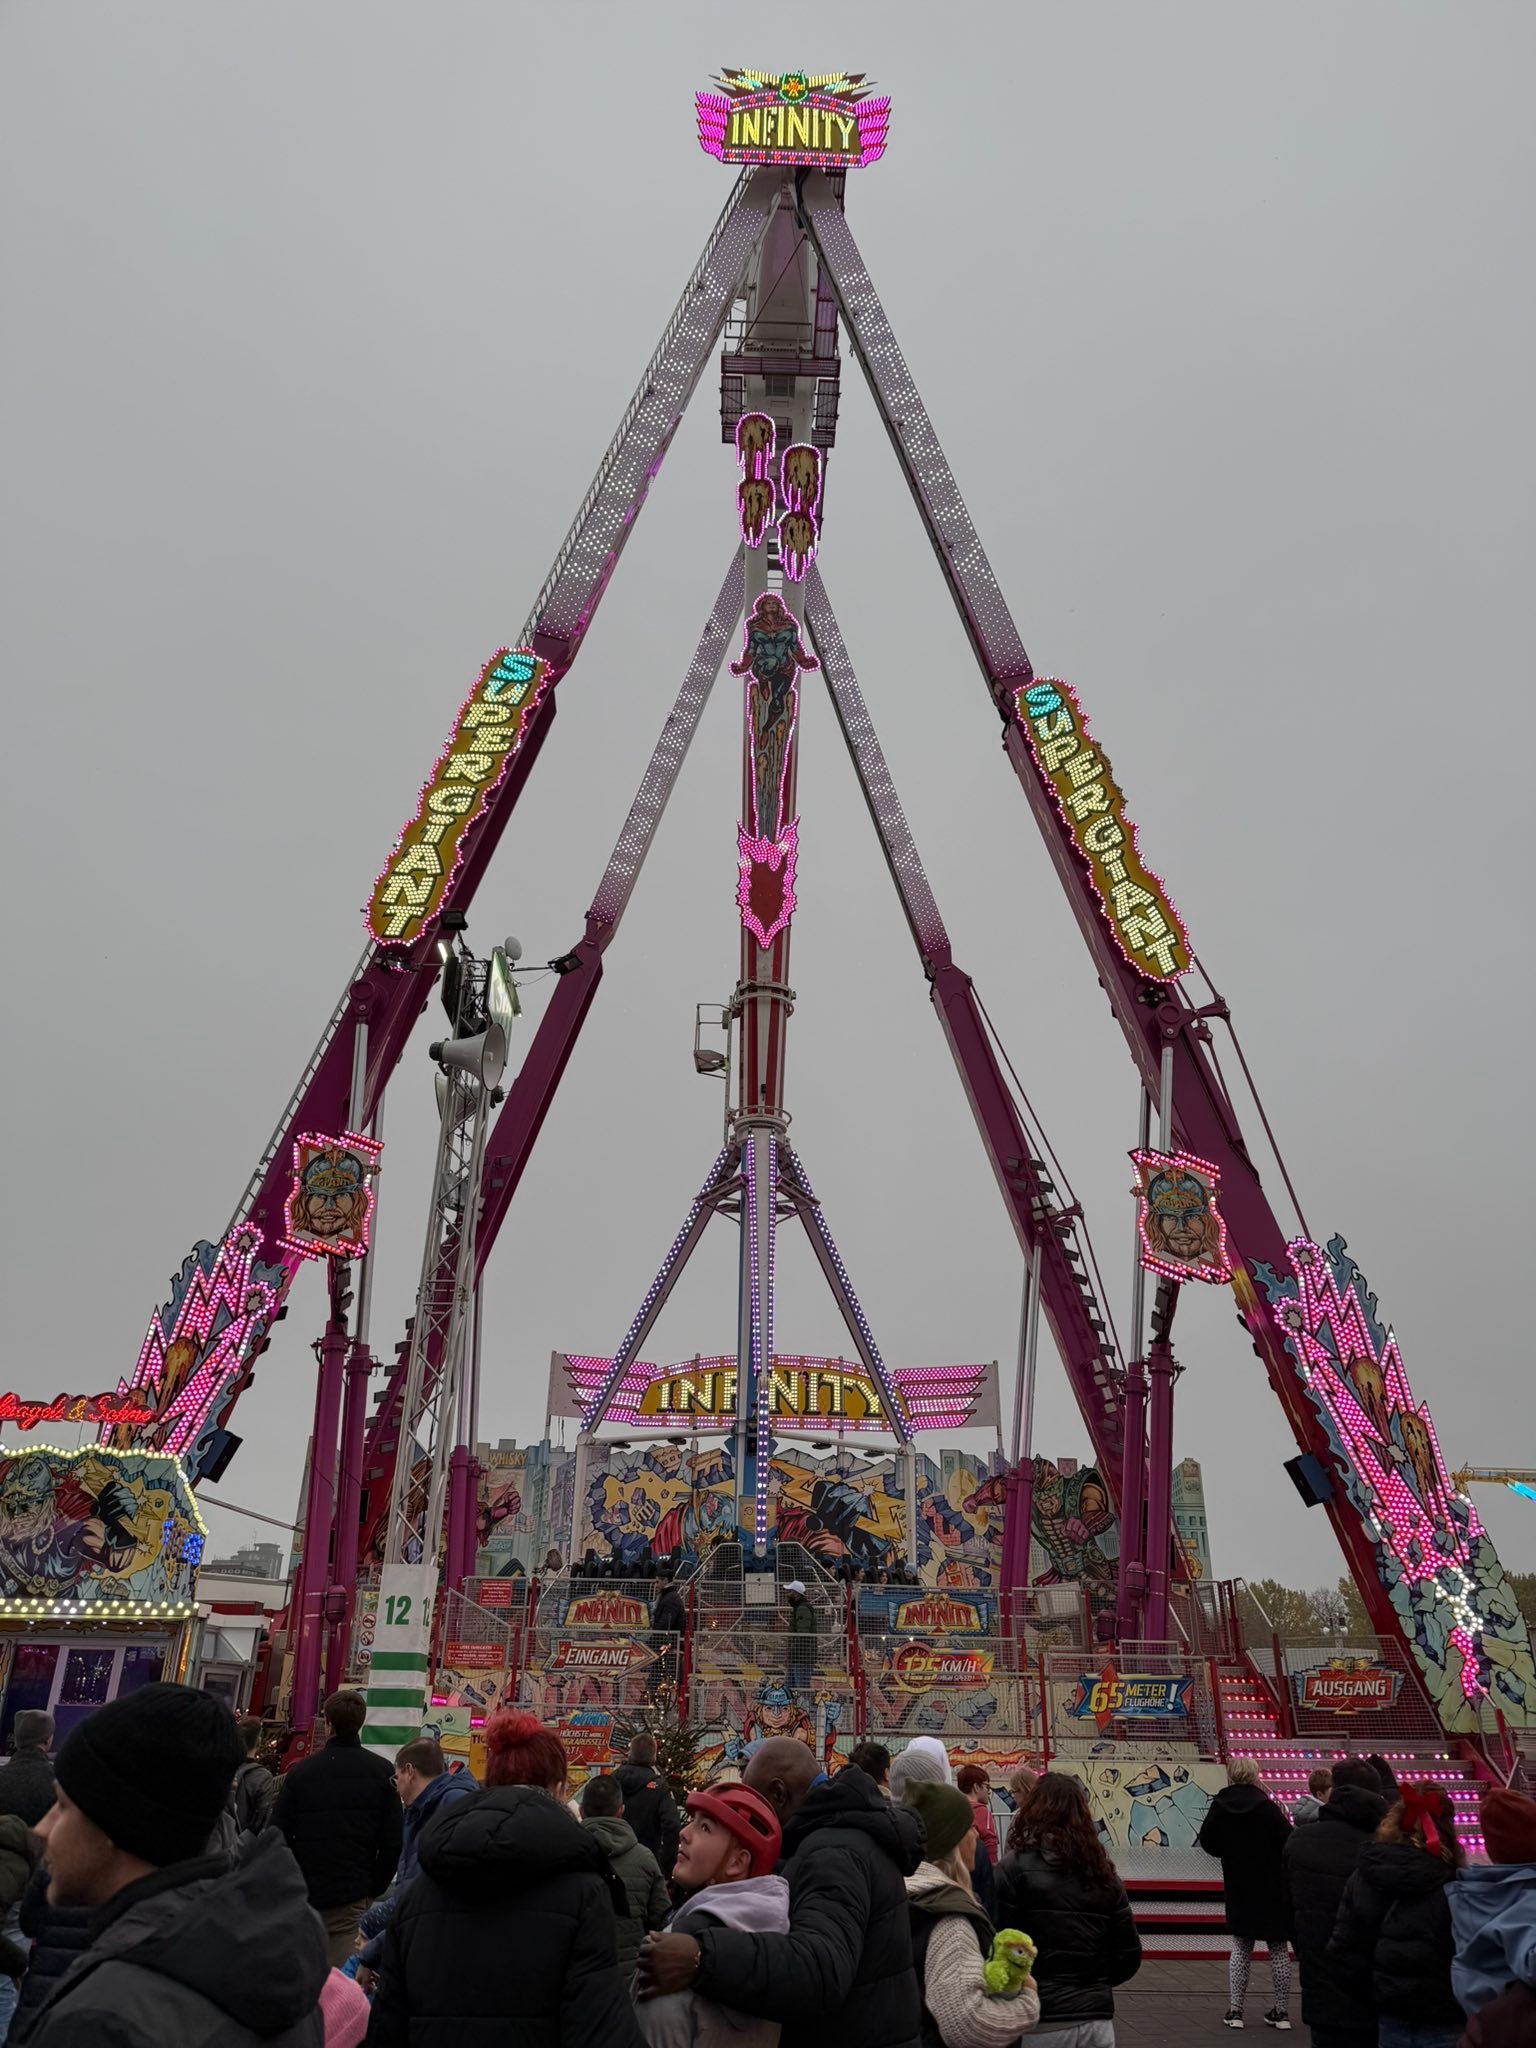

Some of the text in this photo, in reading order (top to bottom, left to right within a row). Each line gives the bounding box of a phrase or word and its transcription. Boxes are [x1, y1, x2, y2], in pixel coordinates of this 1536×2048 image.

[730, 105, 855, 150] INFINITY
[657, 1369, 883, 1416] INFNITY
[490, 1452, 527, 1466] WHISKY
[385, 1595, 412, 1625] 12
[573, 1599, 644, 1625] INFINITY
[902, 1602, 975, 1627] INFINITY
[564, 1647, 631, 1665] EINGANG
[903, 1656, 977, 1681] 125 KM/H
[1089, 1681, 1167, 1713] 65 METER
[1311, 1679, 1386, 1697] AUSGANG
